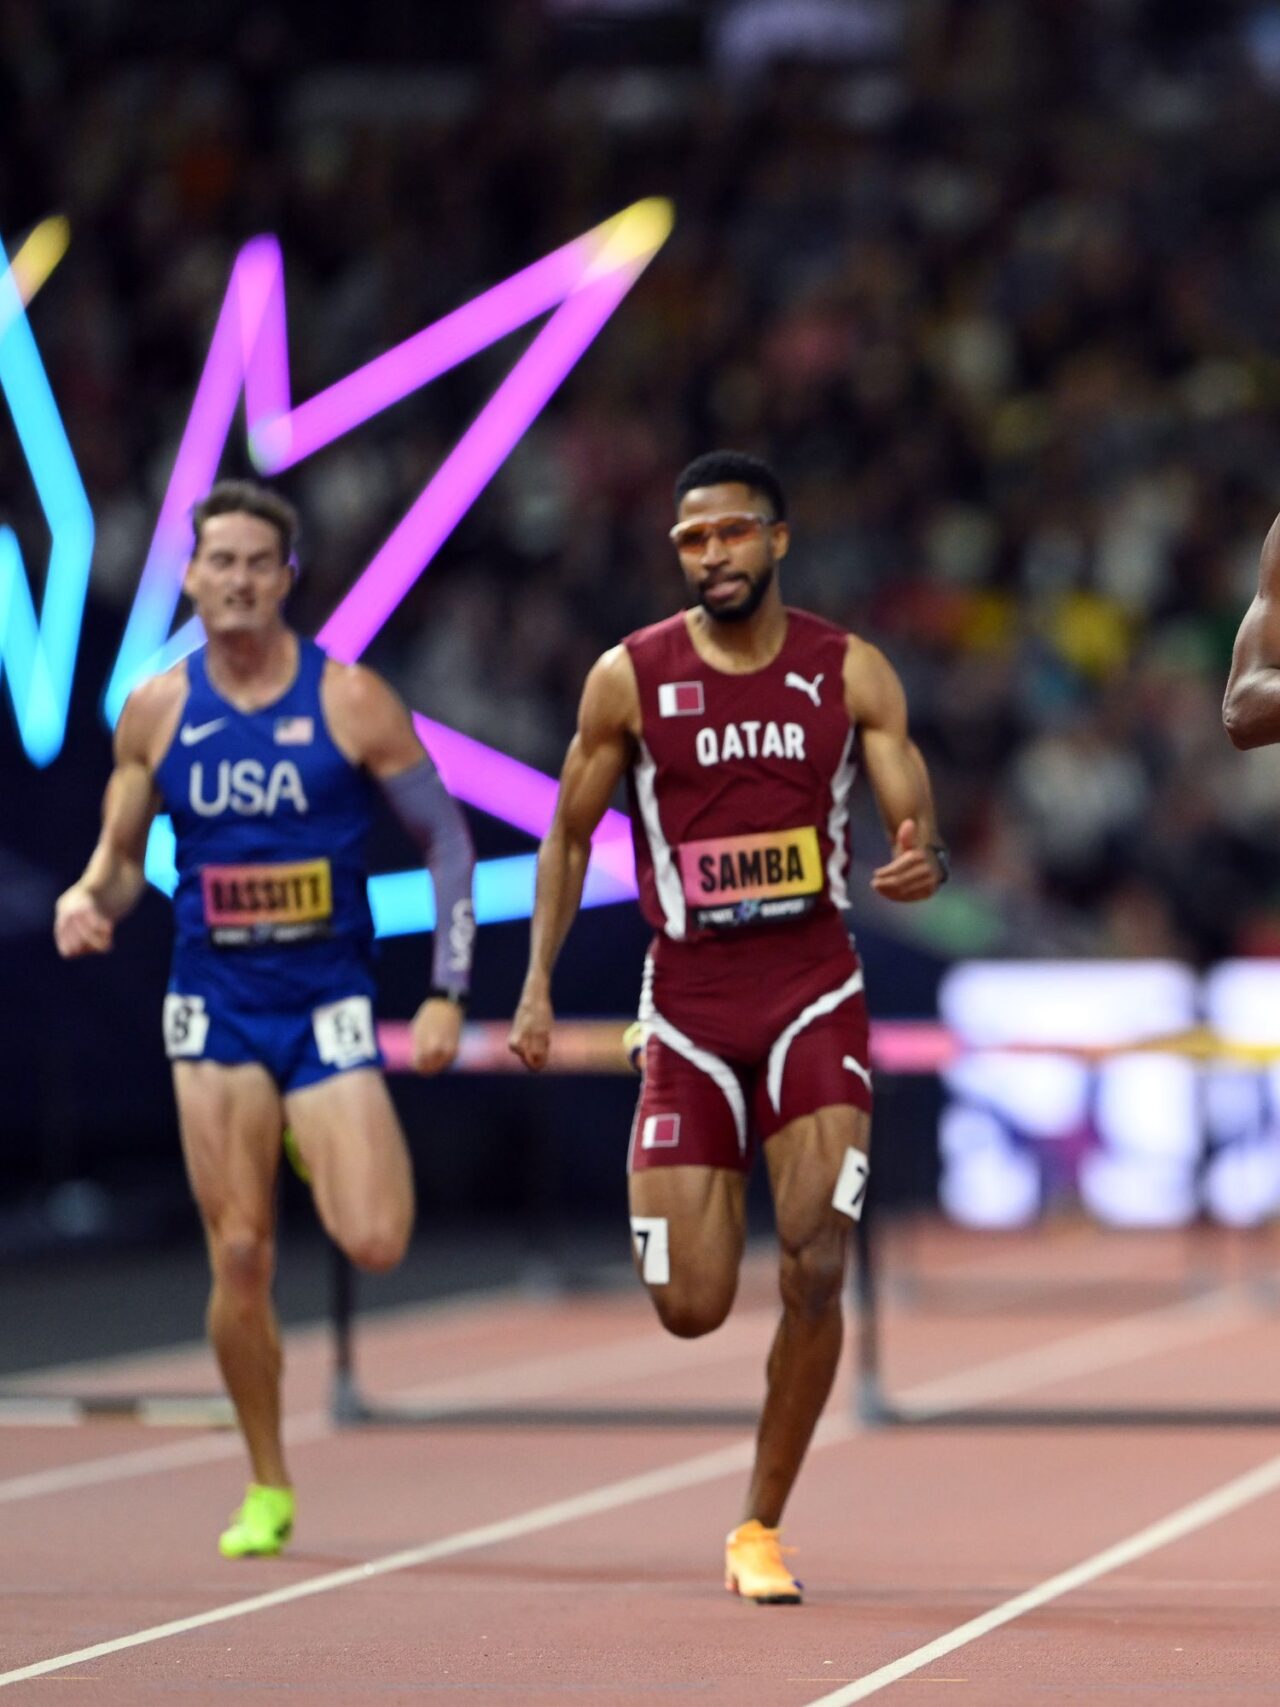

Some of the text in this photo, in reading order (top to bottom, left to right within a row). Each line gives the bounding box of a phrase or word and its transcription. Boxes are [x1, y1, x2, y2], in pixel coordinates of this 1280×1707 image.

[696, 721, 805, 767] QATAR
[189, 760, 308, 816] USA
[698, 845, 805, 893] SAMBA
[852, 1164, 869, 1206] 7
[635, 1231, 650, 1259] 7
